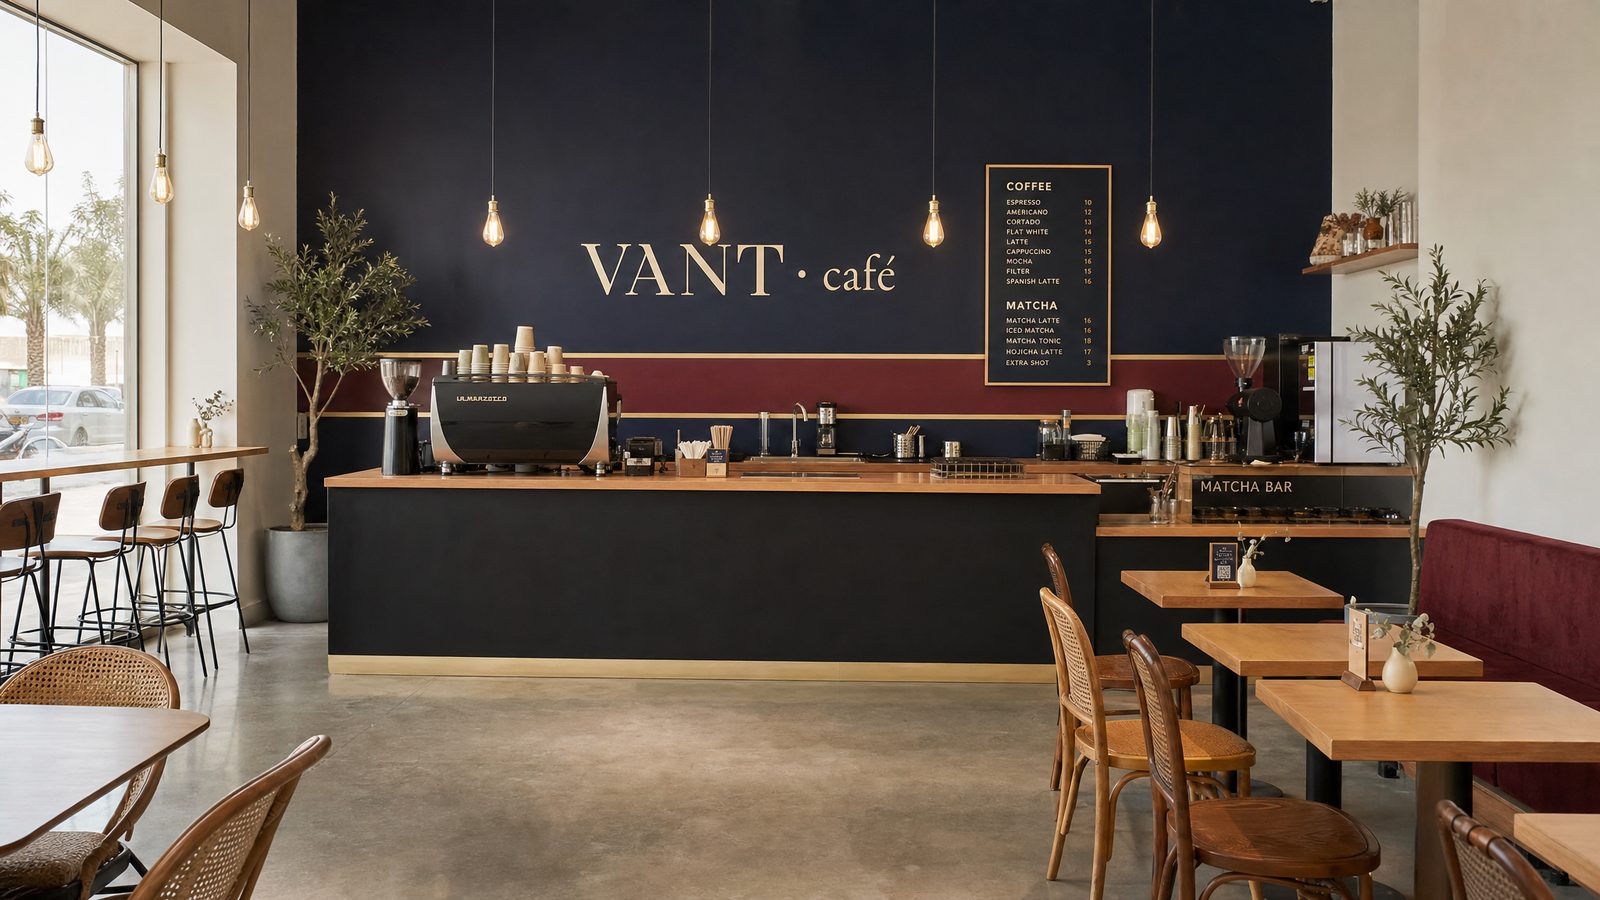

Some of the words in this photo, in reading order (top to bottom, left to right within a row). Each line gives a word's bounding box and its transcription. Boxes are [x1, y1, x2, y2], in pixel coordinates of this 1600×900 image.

[1006, 181, 1052, 191] COFFEE
[1006, 208, 1049, 216] AMERICANO
[1084, 208, 1092, 216] 12
[1006, 218, 1041, 226] CORTADO
[1084, 218, 1092, 226] 13
[1006, 228, 1024, 236] FLAT
[1025, 228, 1049, 236] WHITE
[1084, 228, 1092, 236] 14
[1006, 238, 1029, 246] LATTE
[1084, 238, 1092, 246] 15
[581, 243, 784, 296] VANT
[823, 253, 896, 292] café
[1006, 267, 1030, 275] FILTER
[1084, 267, 1092, 275] 15
[1006, 277, 1037, 285] SPANISH
[1038, 277, 1060, 285] LATTE
[1084, 277, 1092, 285] 16
[1006, 301, 1058, 311] MATCHA
[1006, 337, 1037, 345] MATCHA
[1038, 337, 1062, 345] TONIC
[1083, 337, 1092, 345] 18
[1006, 348, 1039, 356] HOJICHA
[1040, 348, 1063, 356] LATTE
[1083, 348, 1092, 356] 17
[1200, 480, 1260, 493] MATCHA
[1265, 480, 1293, 493] BAR
